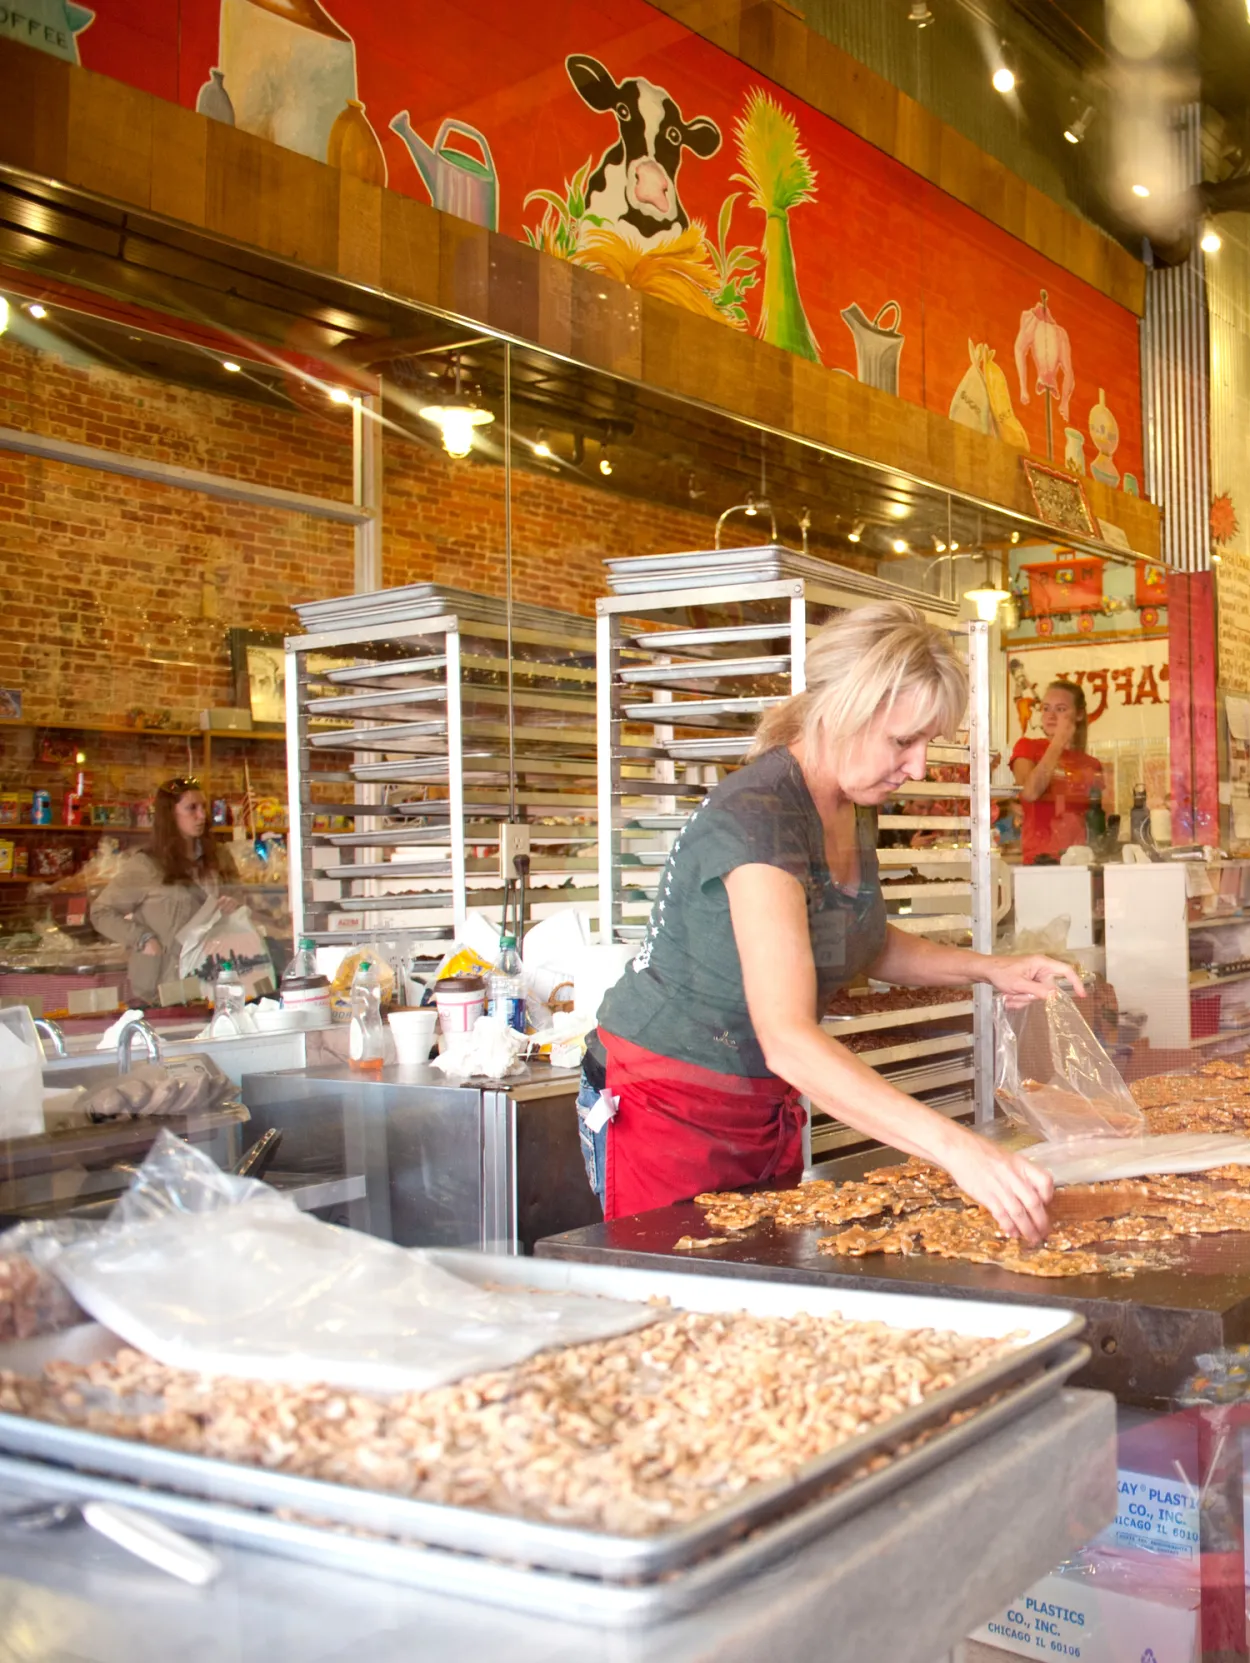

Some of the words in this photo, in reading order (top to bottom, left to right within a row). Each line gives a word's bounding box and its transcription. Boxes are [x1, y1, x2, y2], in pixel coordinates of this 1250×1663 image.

[1149, 1488, 1198, 1509] PLASTI
[1128, 1503, 1153, 1520] CO.,
[1158, 1508, 1187, 1525] INC.
[1157, 1523, 1168, 1535] IL
[1007, 1610, 1031, 1629] CO.,
[1034, 1618, 1061, 1636] INC.
[1025, 1597, 1085, 1626] PLASTICS
[988, 1622, 1031, 1643] CHICAGO
[1035, 1636, 1046, 1648] IL
[1050, 1640, 1081, 1657] 60106
